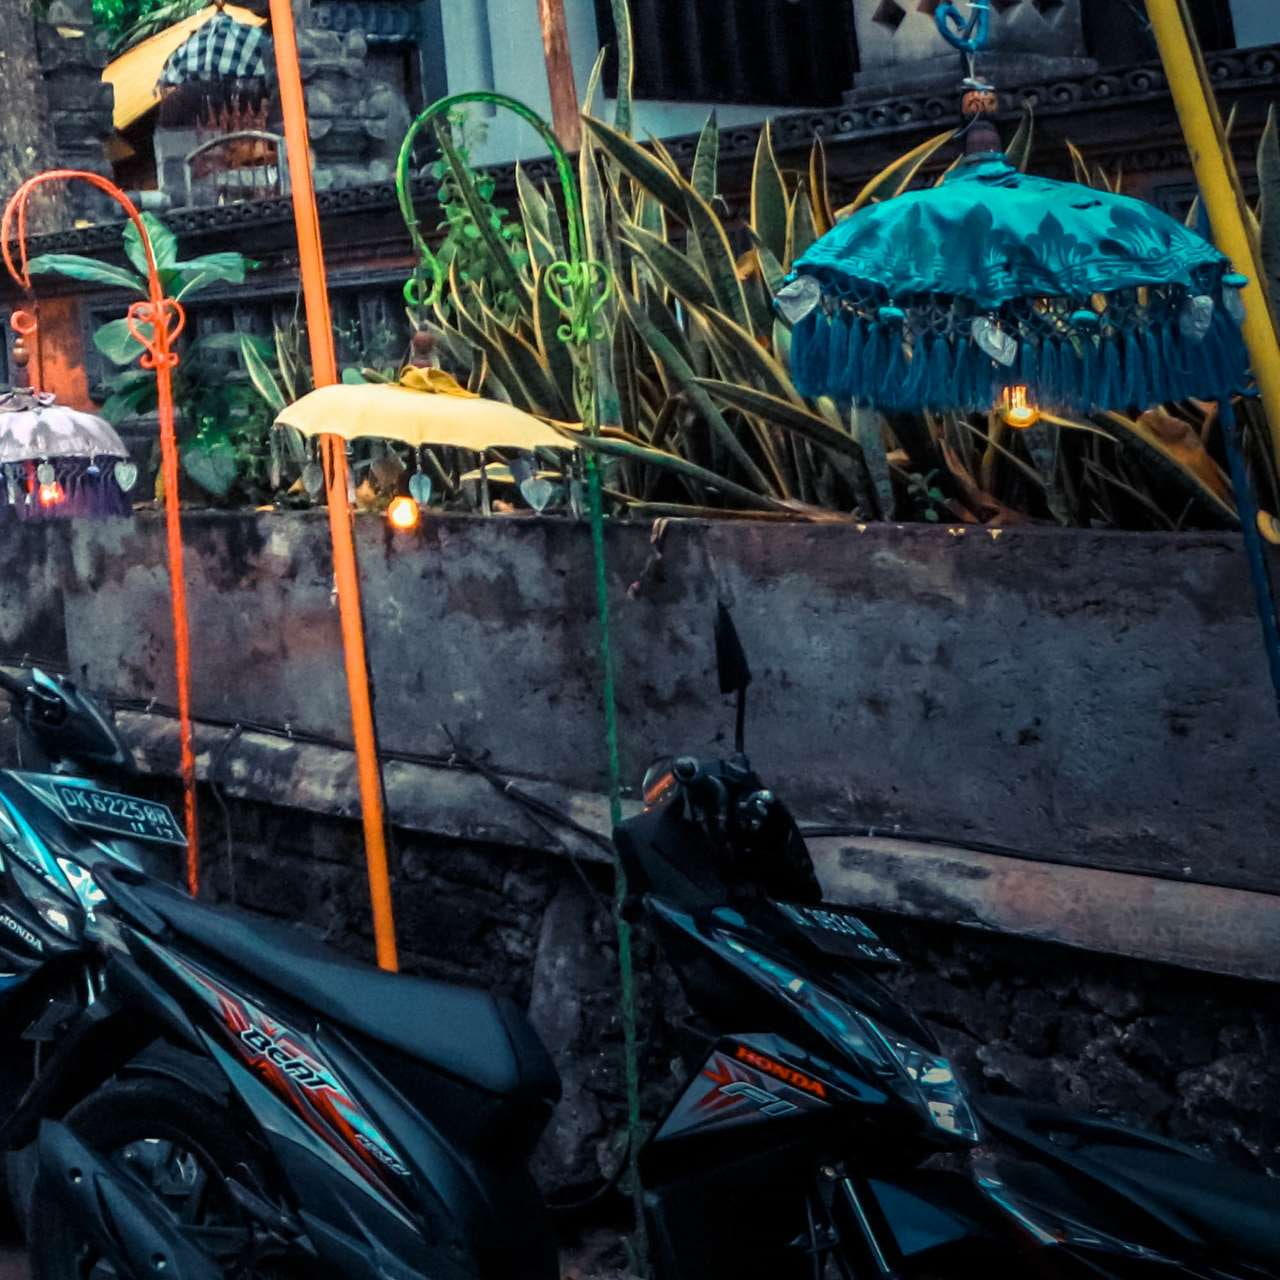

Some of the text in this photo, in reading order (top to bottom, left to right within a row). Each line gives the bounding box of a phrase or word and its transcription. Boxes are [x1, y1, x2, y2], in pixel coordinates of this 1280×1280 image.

[61, 787, 92, 809] DK
[91, 794, 145, 821] 6225
[735, 1043, 827, 1098] HONDA
